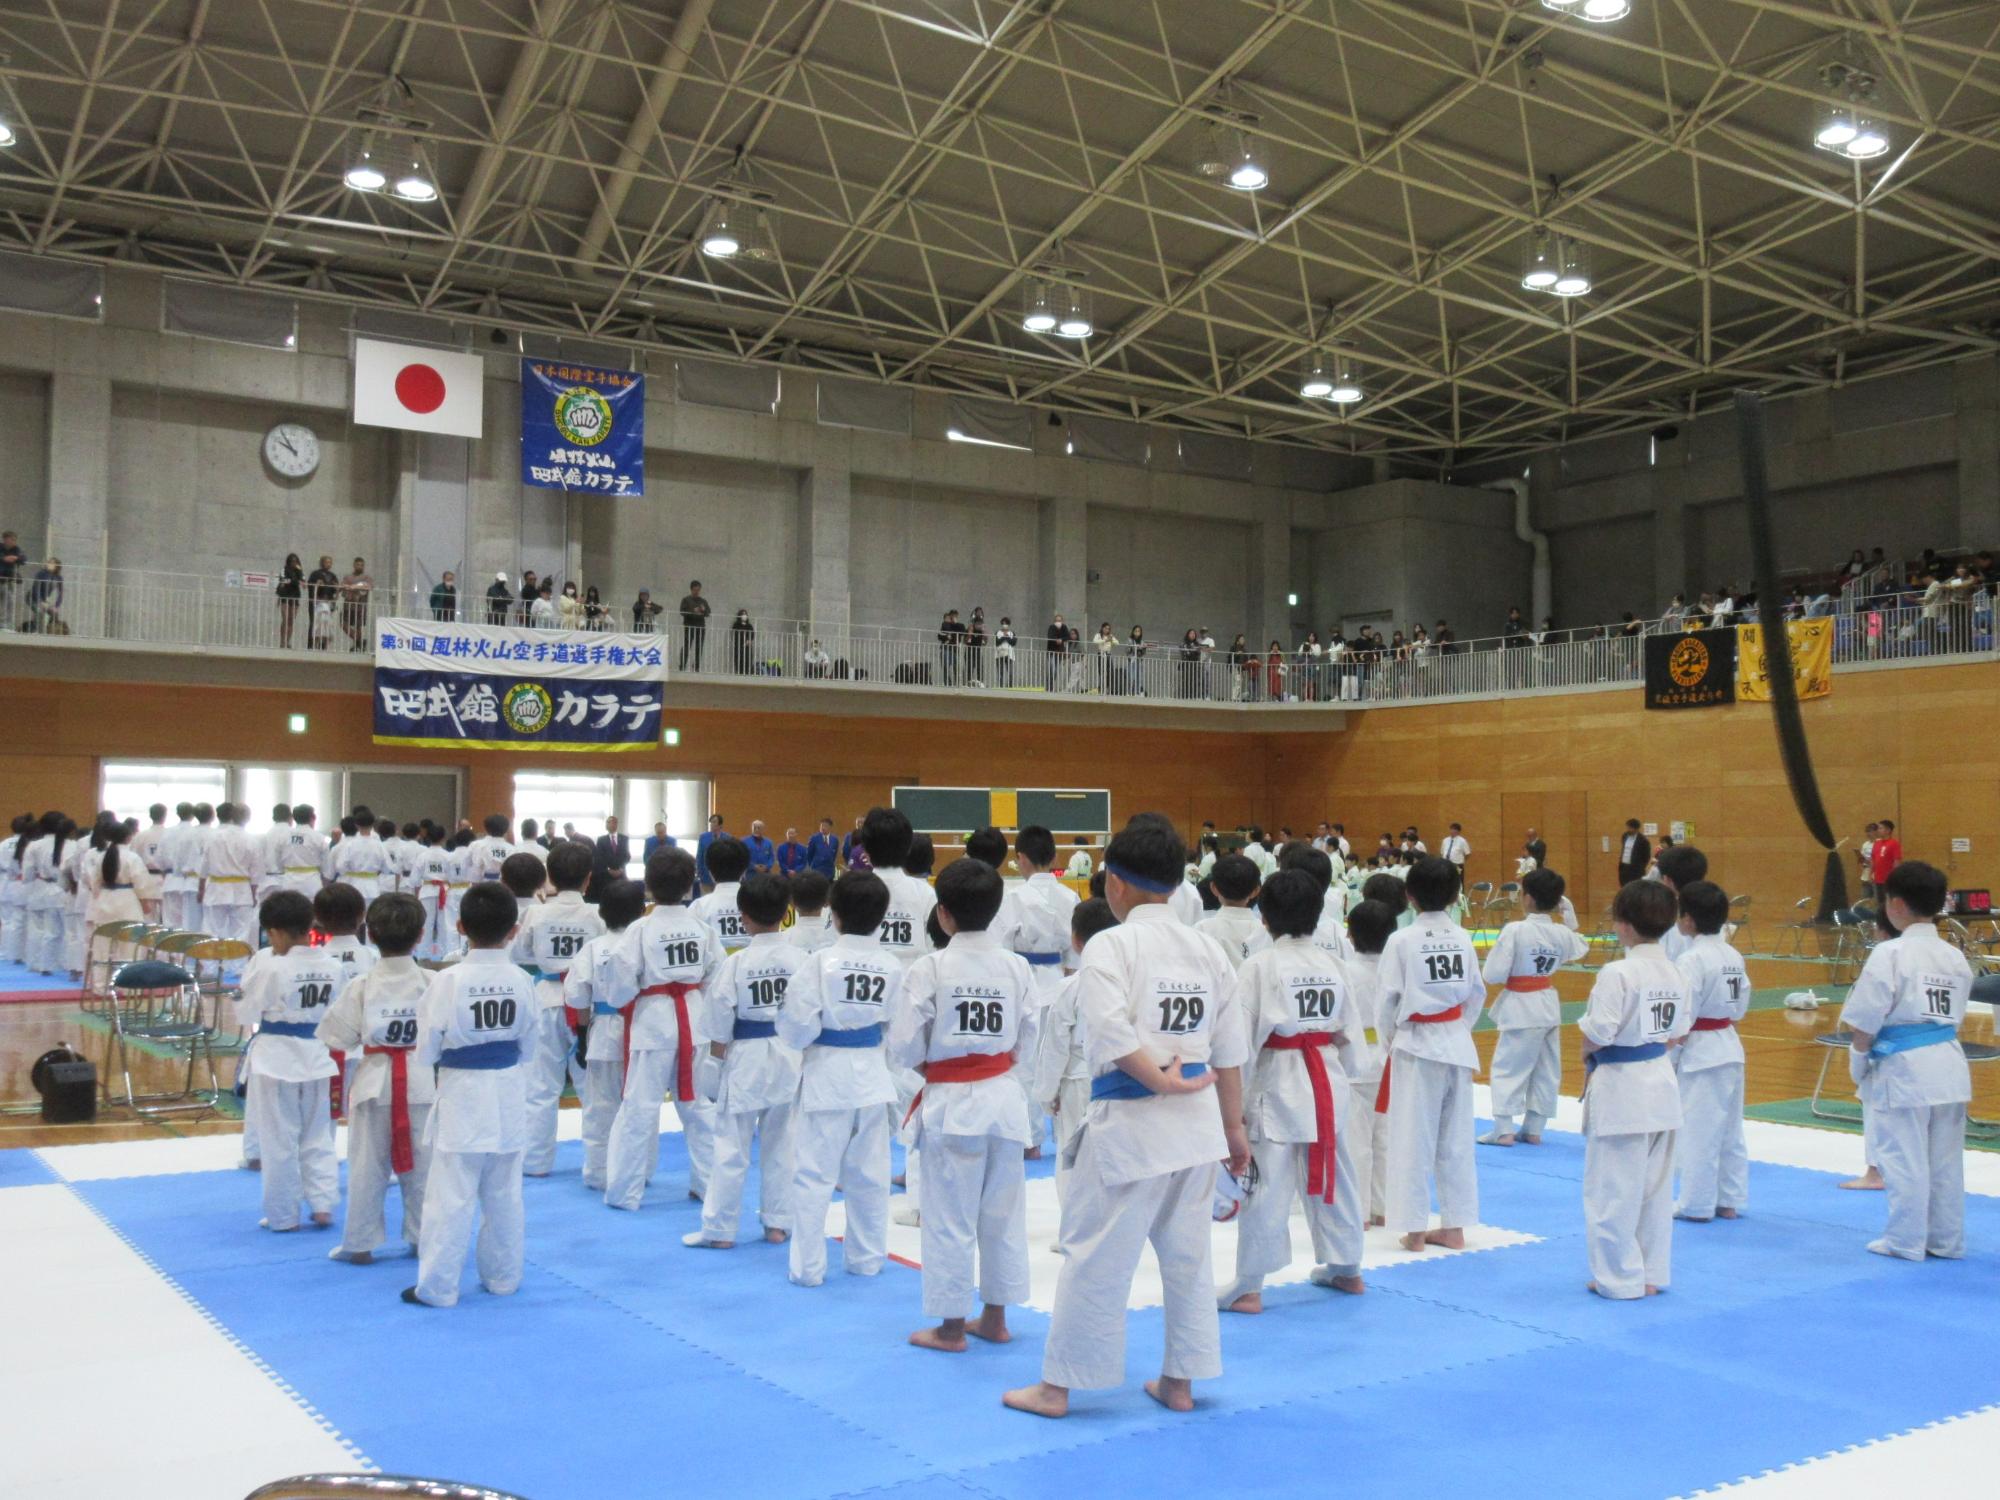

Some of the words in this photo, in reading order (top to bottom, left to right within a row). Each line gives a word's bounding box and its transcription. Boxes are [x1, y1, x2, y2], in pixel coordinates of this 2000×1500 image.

[554, 690, 662, 731] カラテ
[550, 935, 584, 957] 131
[880, 920, 912, 943] 213
[664, 941, 699, 966] 116
[1425, 954, 1464, 981] 134
[298, 983, 332, 1008] 104
[748, 977, 788, 1006] 109
[844, 973, 886, 1003] 132
[1926, 987, 1951, 1015] 115
[469, 998, 516, 1029] 100
[955, 1000, 1003, 1033] 136
[1159, 996, 1205, 1031] 129
[1294, 988, 1335, 1019] 120
[1650, 1002, 1676, 1031] 119
[385, 1019, 418, 1043] 99
